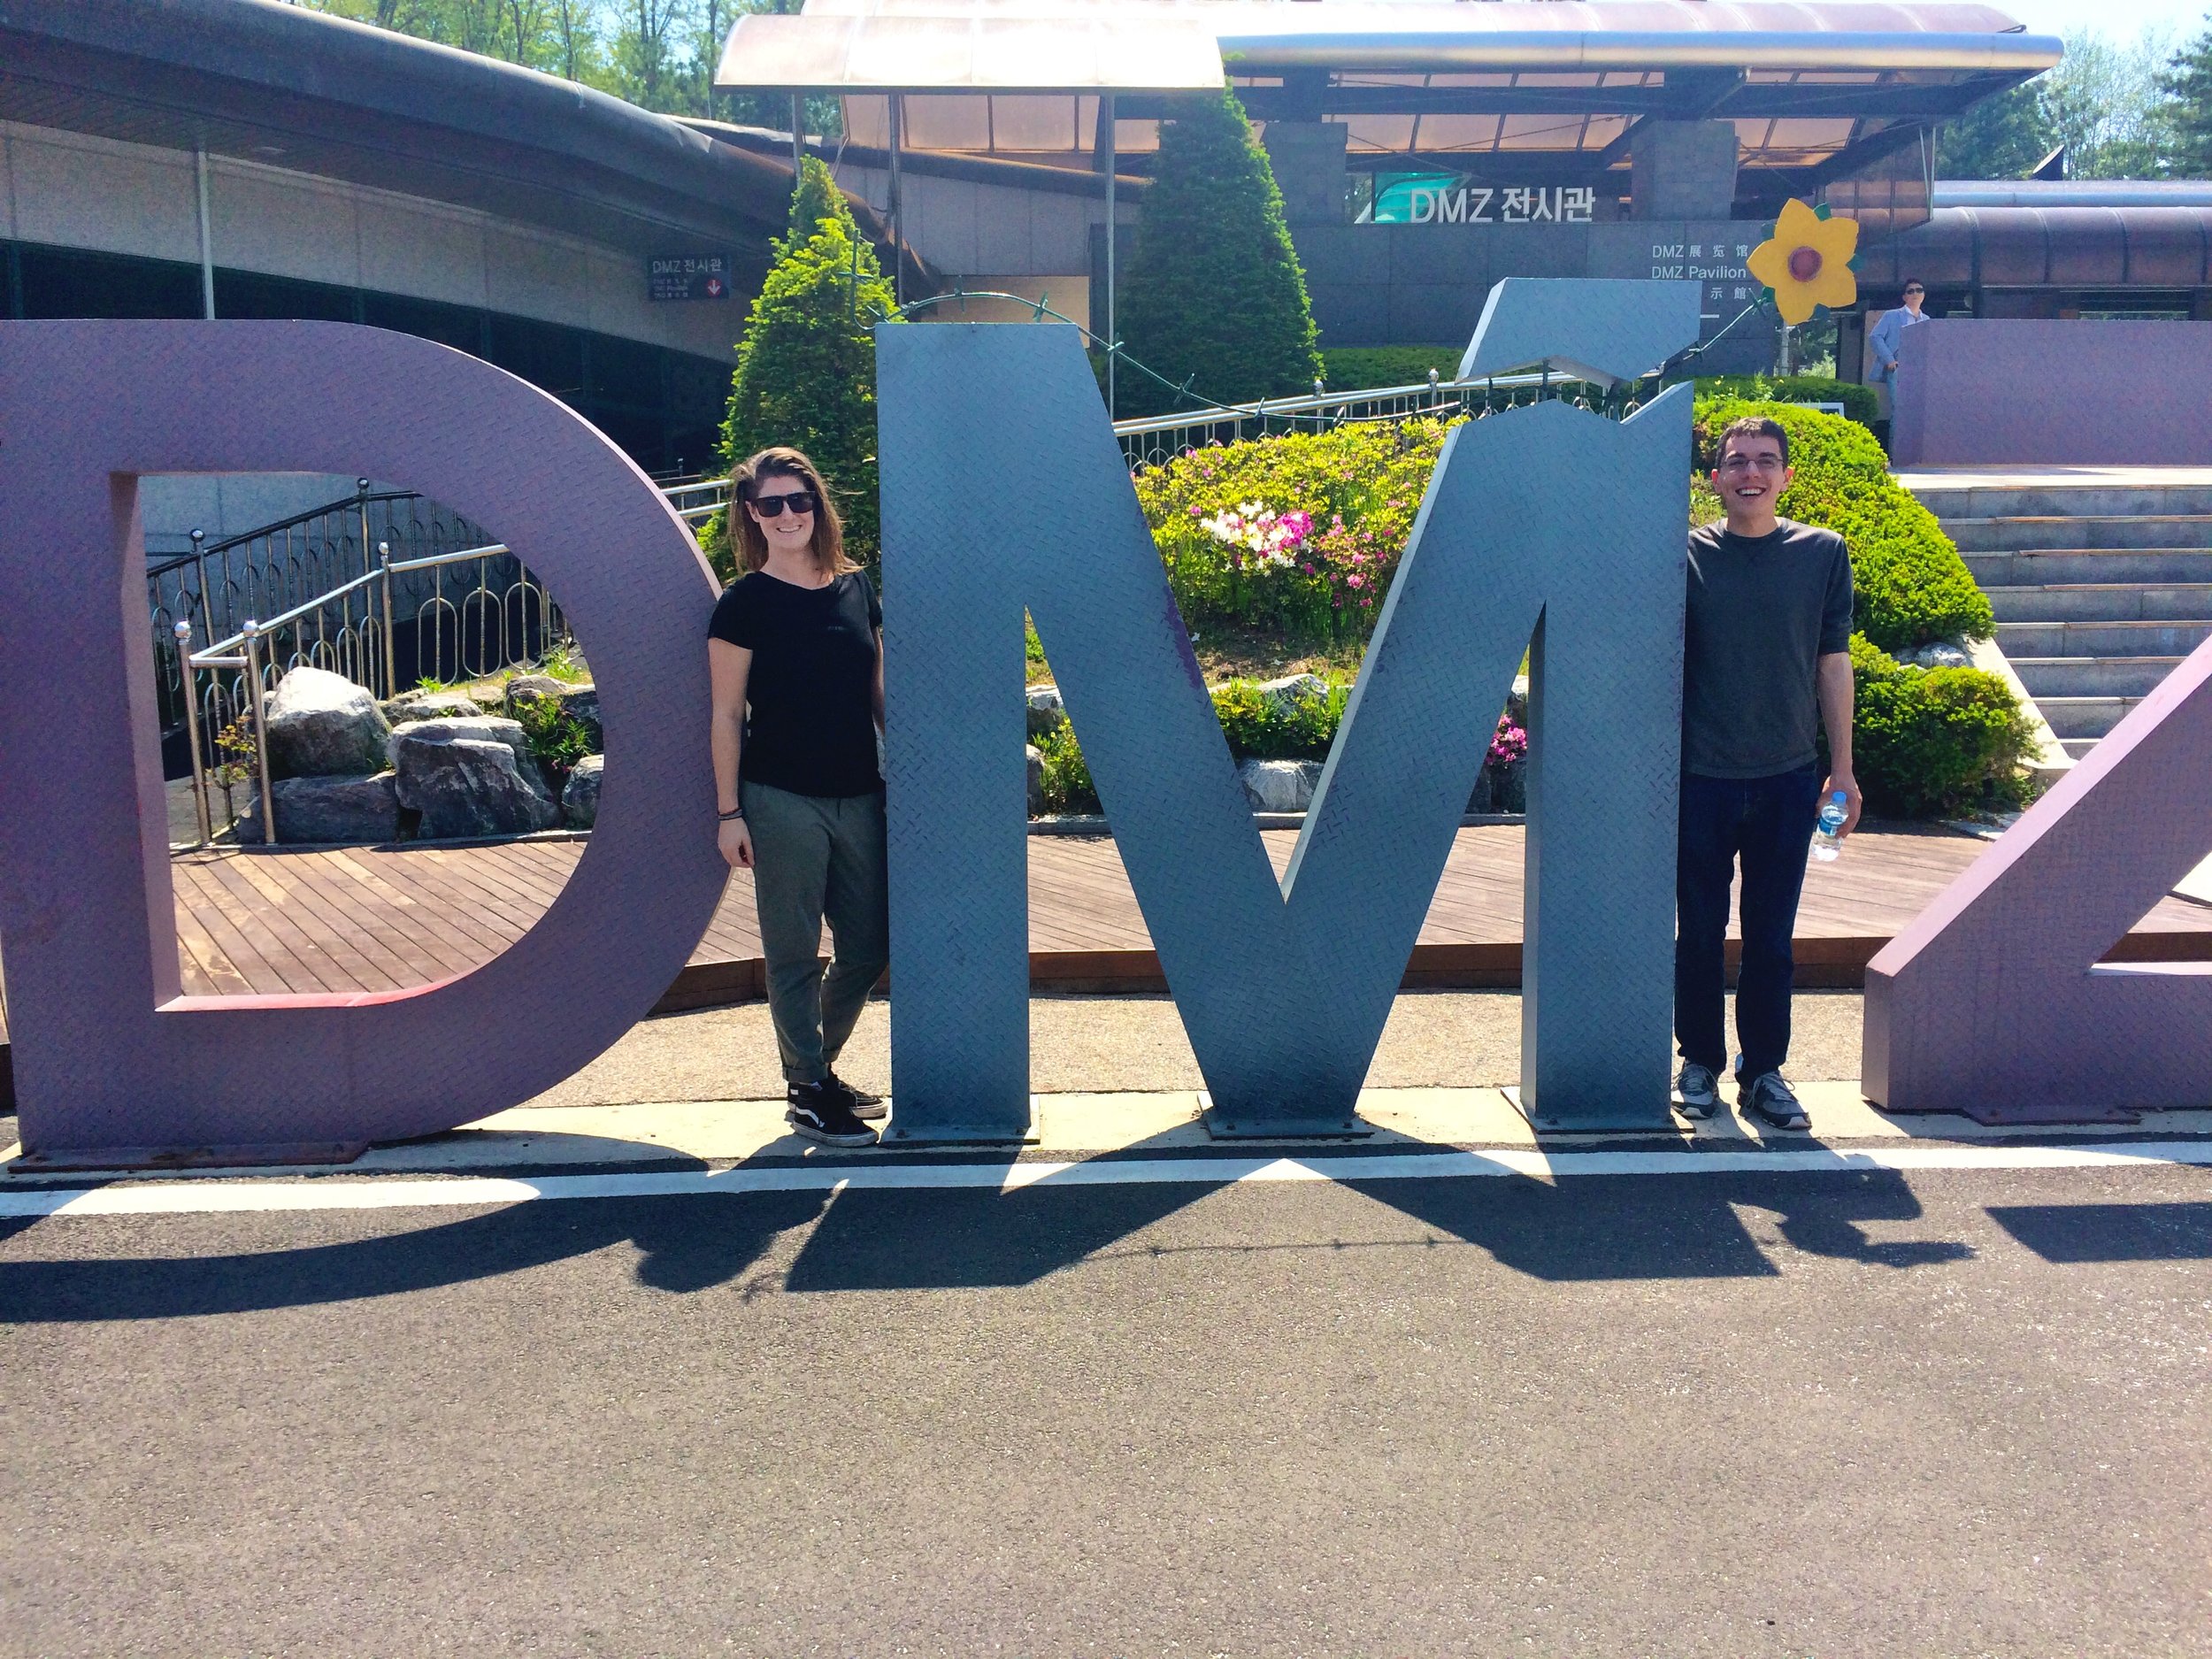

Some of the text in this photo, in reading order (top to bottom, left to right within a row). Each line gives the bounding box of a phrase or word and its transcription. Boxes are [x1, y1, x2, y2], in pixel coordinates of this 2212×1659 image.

[1409, 187, 1596, 223] DMZ 전시관
[1652, 244, 1748, 258] DMZ 展览馆
[652, 258, 722, 273] DMZ 전시관
[1651, 265, 1747, 280] DMZ Pavilion
